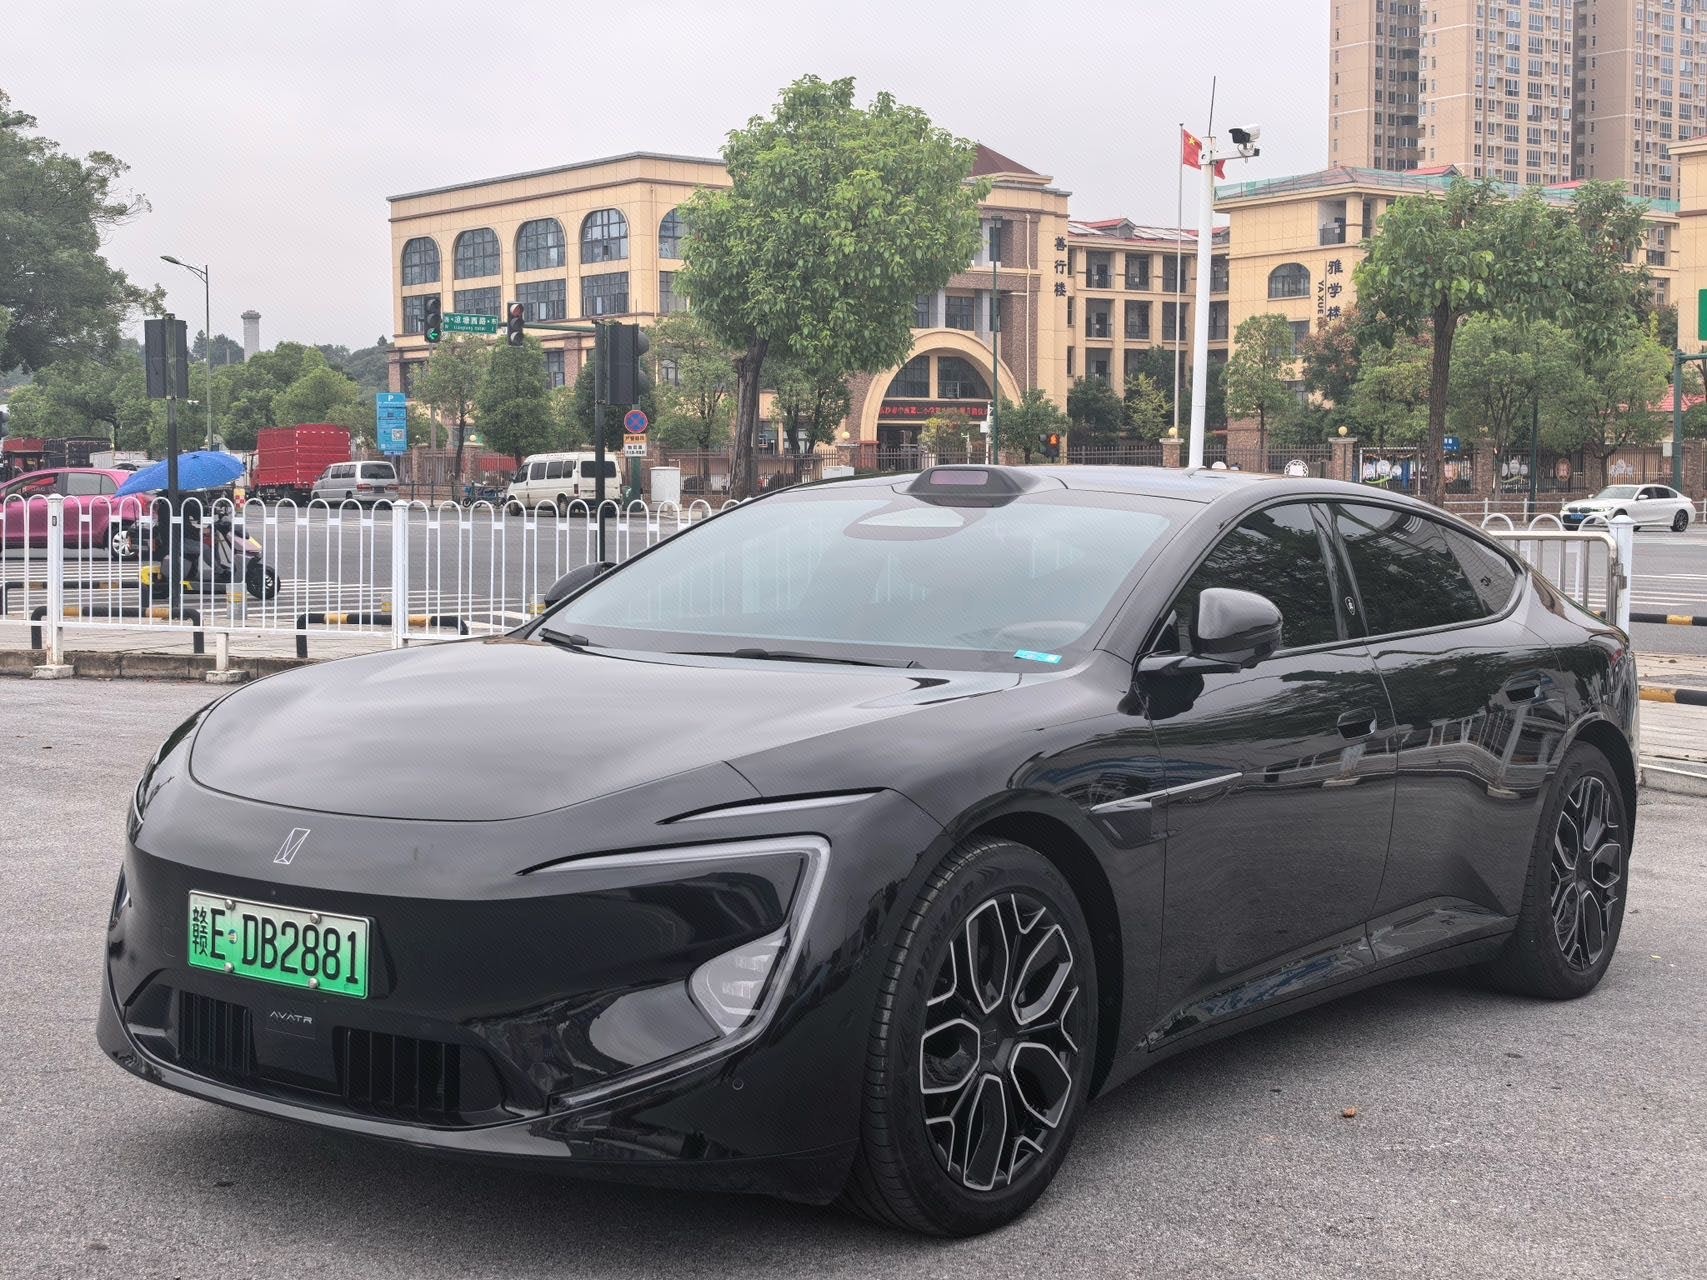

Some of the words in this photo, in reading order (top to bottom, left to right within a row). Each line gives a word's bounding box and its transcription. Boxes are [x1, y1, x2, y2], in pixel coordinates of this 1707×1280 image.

[1054, 236, 1067, 297] 善行楼
[1327, 259, 1343, 321] 雅学楼
[270, 1010, 313, 1024] AVATR
